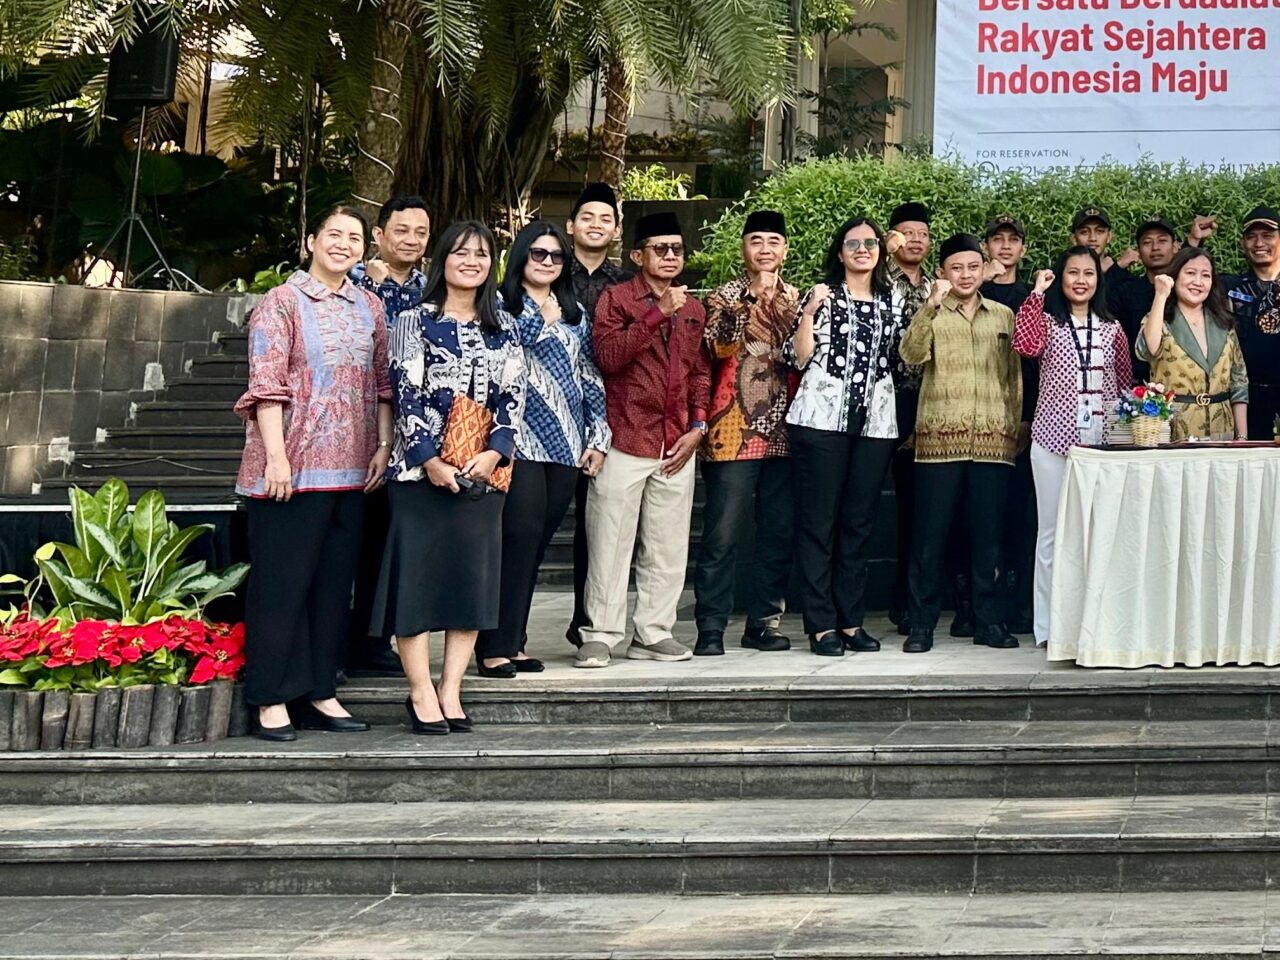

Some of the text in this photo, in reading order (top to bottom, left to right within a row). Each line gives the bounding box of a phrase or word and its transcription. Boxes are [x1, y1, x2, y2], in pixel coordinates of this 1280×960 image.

[977, 19, 1266, 61] Rakyat Sejahtera
[976, 60, 1228, 101] Indonesia Maju
[976, 150, 996, 158] FOR
